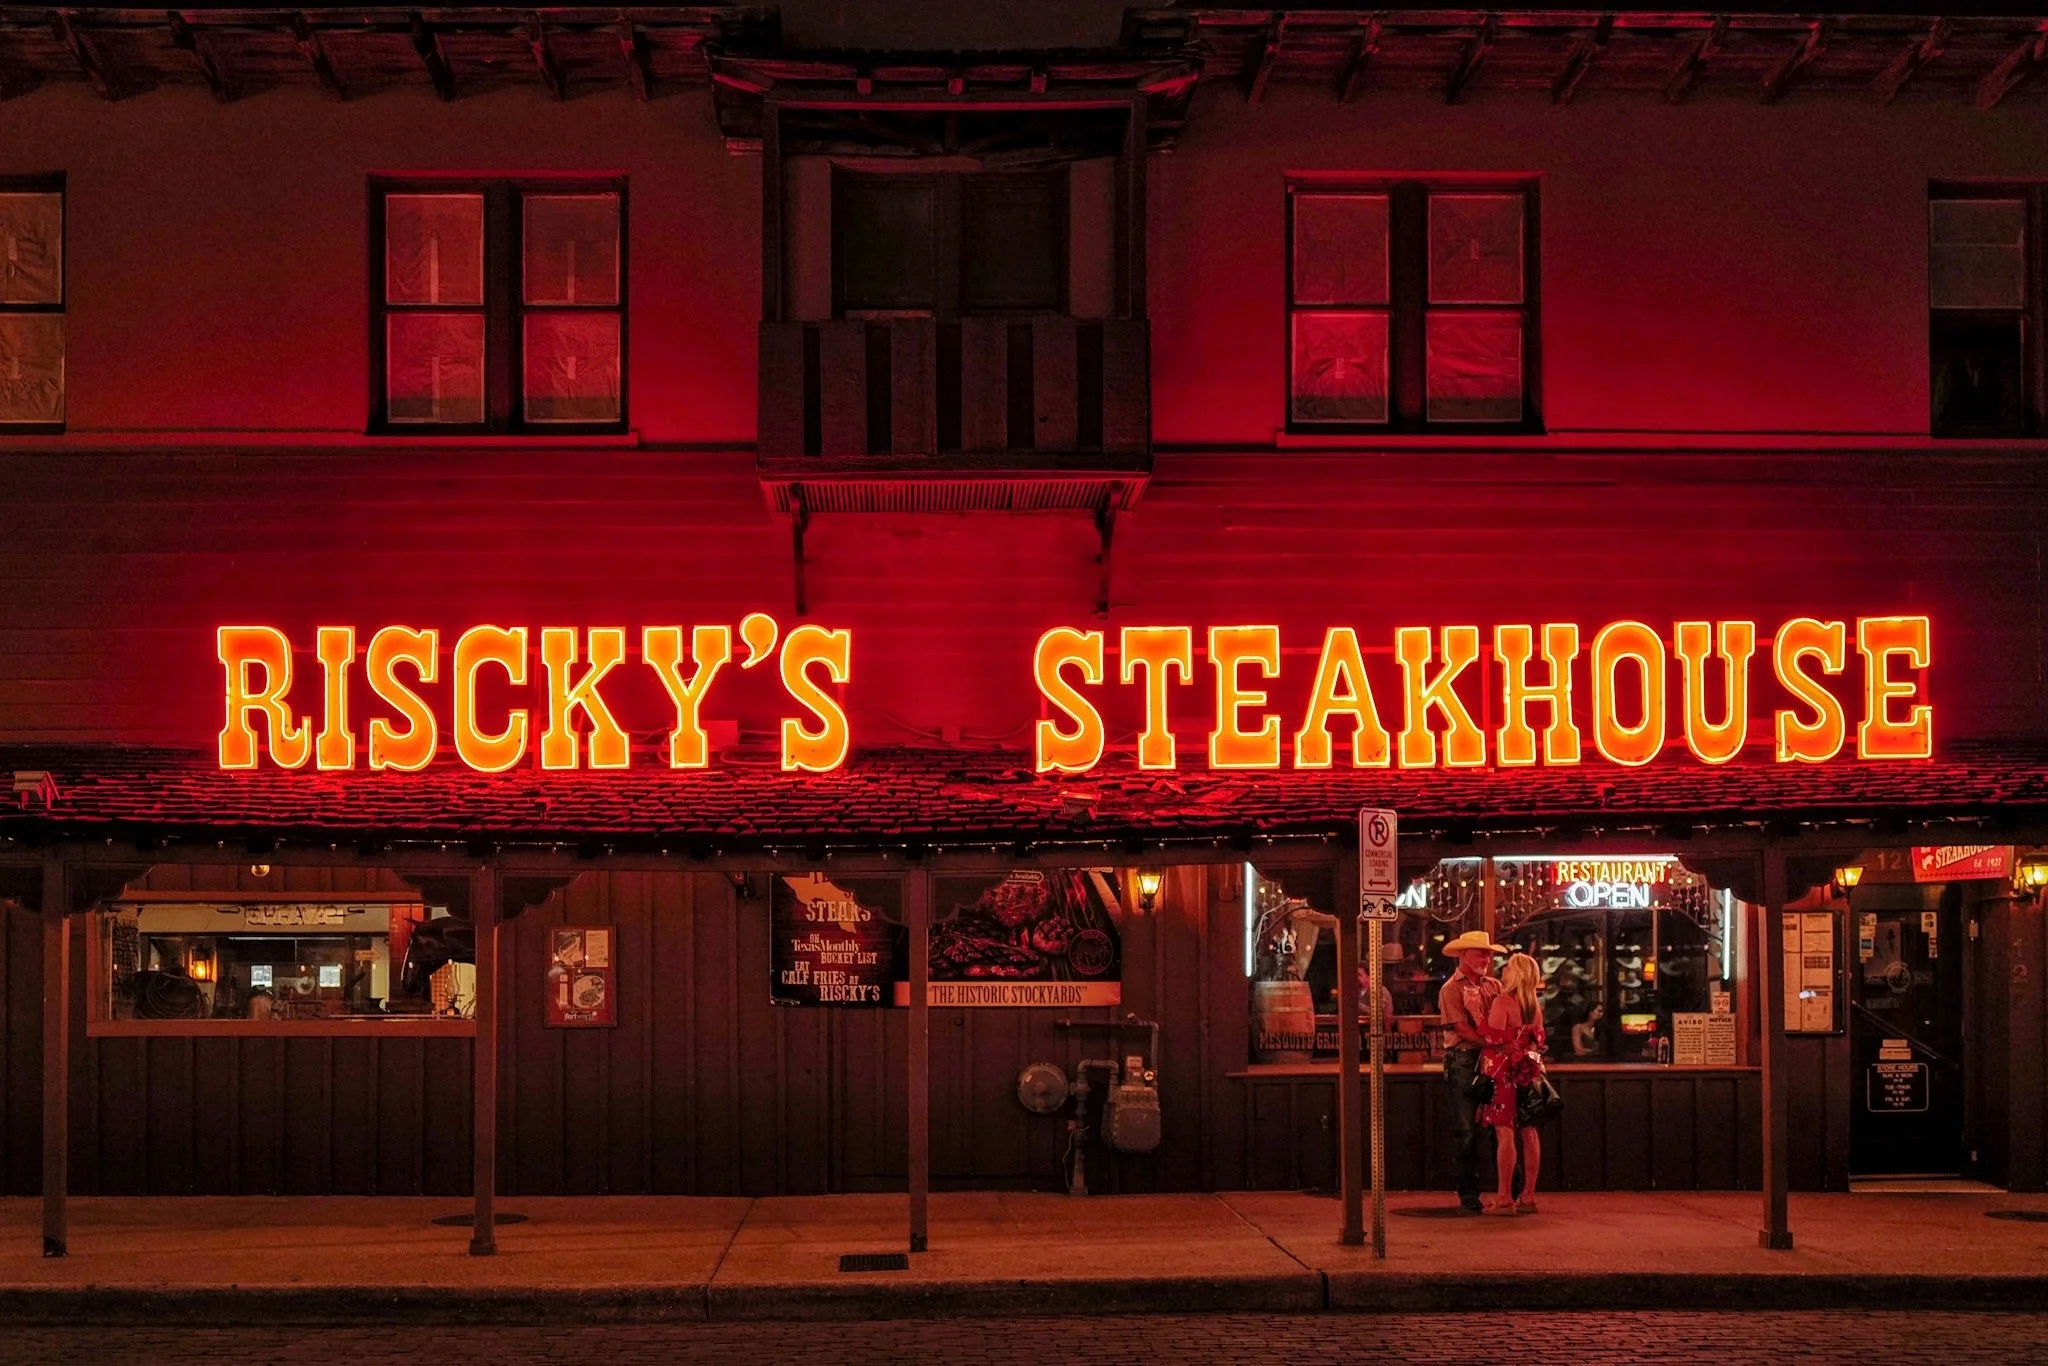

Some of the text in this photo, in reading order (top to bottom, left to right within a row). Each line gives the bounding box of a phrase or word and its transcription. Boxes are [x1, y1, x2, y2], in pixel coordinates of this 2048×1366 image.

[217, 612, 1933, 775] RISCKY'S STEAKHOUSE
[1365, 849, 1393, 858] COMMERCIAL
[1370, 859, 1389, 867] LOADING
[1375, 868, 1385, 876] ZONE
[1557, 861, 1668, 884] RESTAURANT
[1566, 881, 1650, 907] OPEN
[806, 900, 872, 922] STEAKS
[809, 933, 820, 943] ON
[794, 961, 811, 971] EAT
[820, 952, 878, 965] BUCKET LIST
[781, 970, 860, 985] CALF FRIES AT
[819, 985, 881, 1002] RISCKY'S
[957, 986, 1009, 1003] HISTORIC
[1258, 1032, 1315, 1050] MESQUITE
